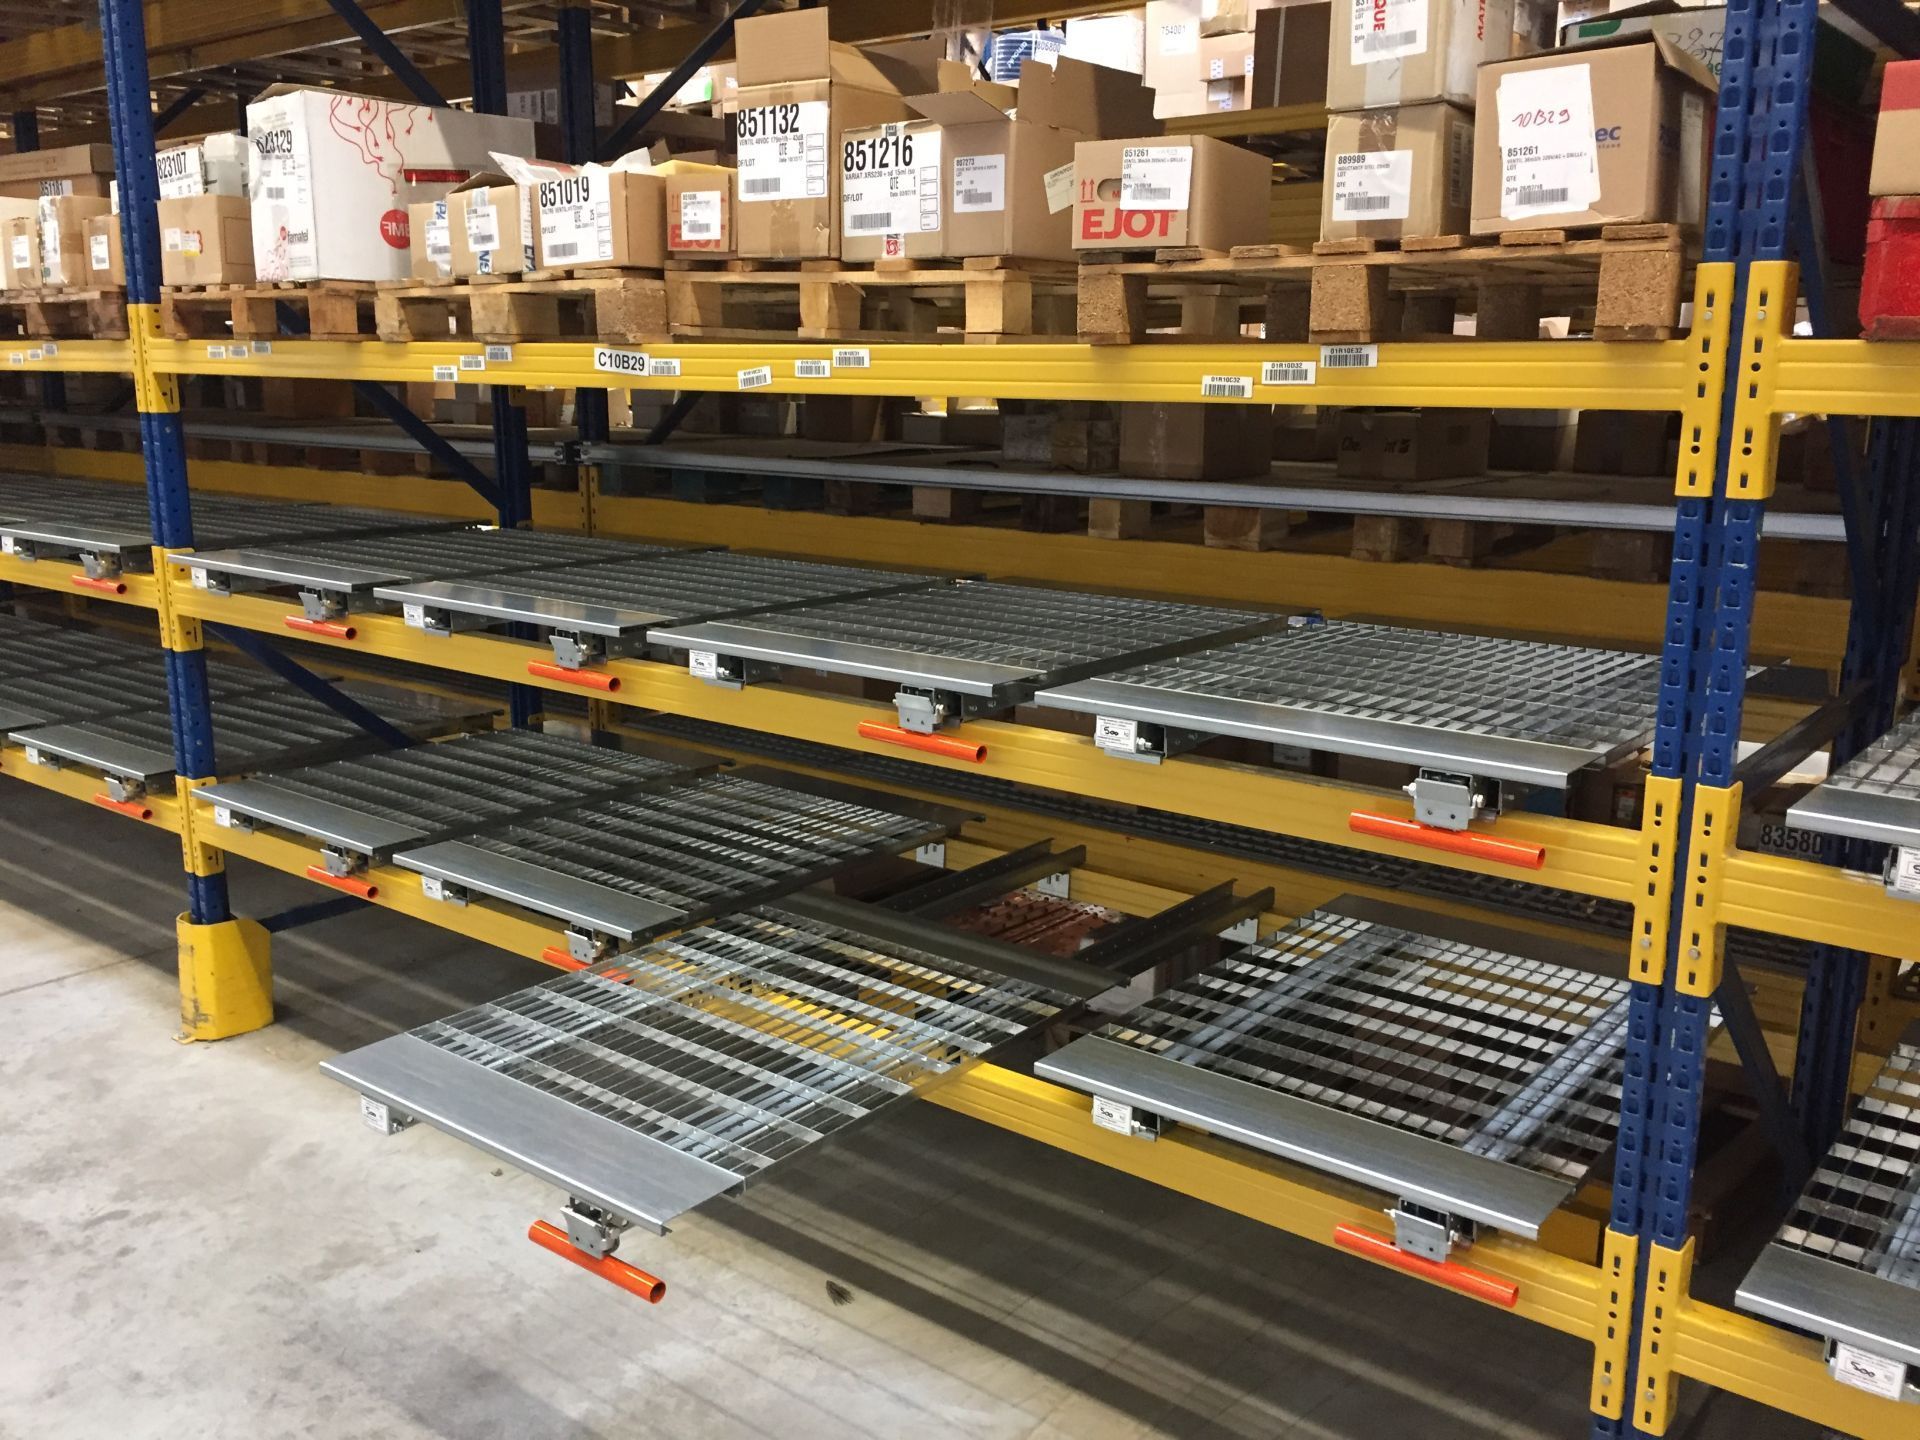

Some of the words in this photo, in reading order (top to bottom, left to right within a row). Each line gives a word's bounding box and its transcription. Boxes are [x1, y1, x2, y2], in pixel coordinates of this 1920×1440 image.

[738, 103, 799, 138] 851132
[844, 135, 913, 172] 851216
[1124, 149, 1149, 157] 851261
[1338, 155, 1366, 164] 889989
[1507, 146, 1539, 157] 851261
[158, 151, 186, 179] 823107
[540, 176, 589, 207] 851019
[889, 177, 899, 190] QTE
[1082, 208, 1178, 240] EJOT
[1330, 347, 1362, 355] 01R10E32
[599, 352, 645, 372] C10B29
[1211, 376, 1241, 384] 01R10C32
